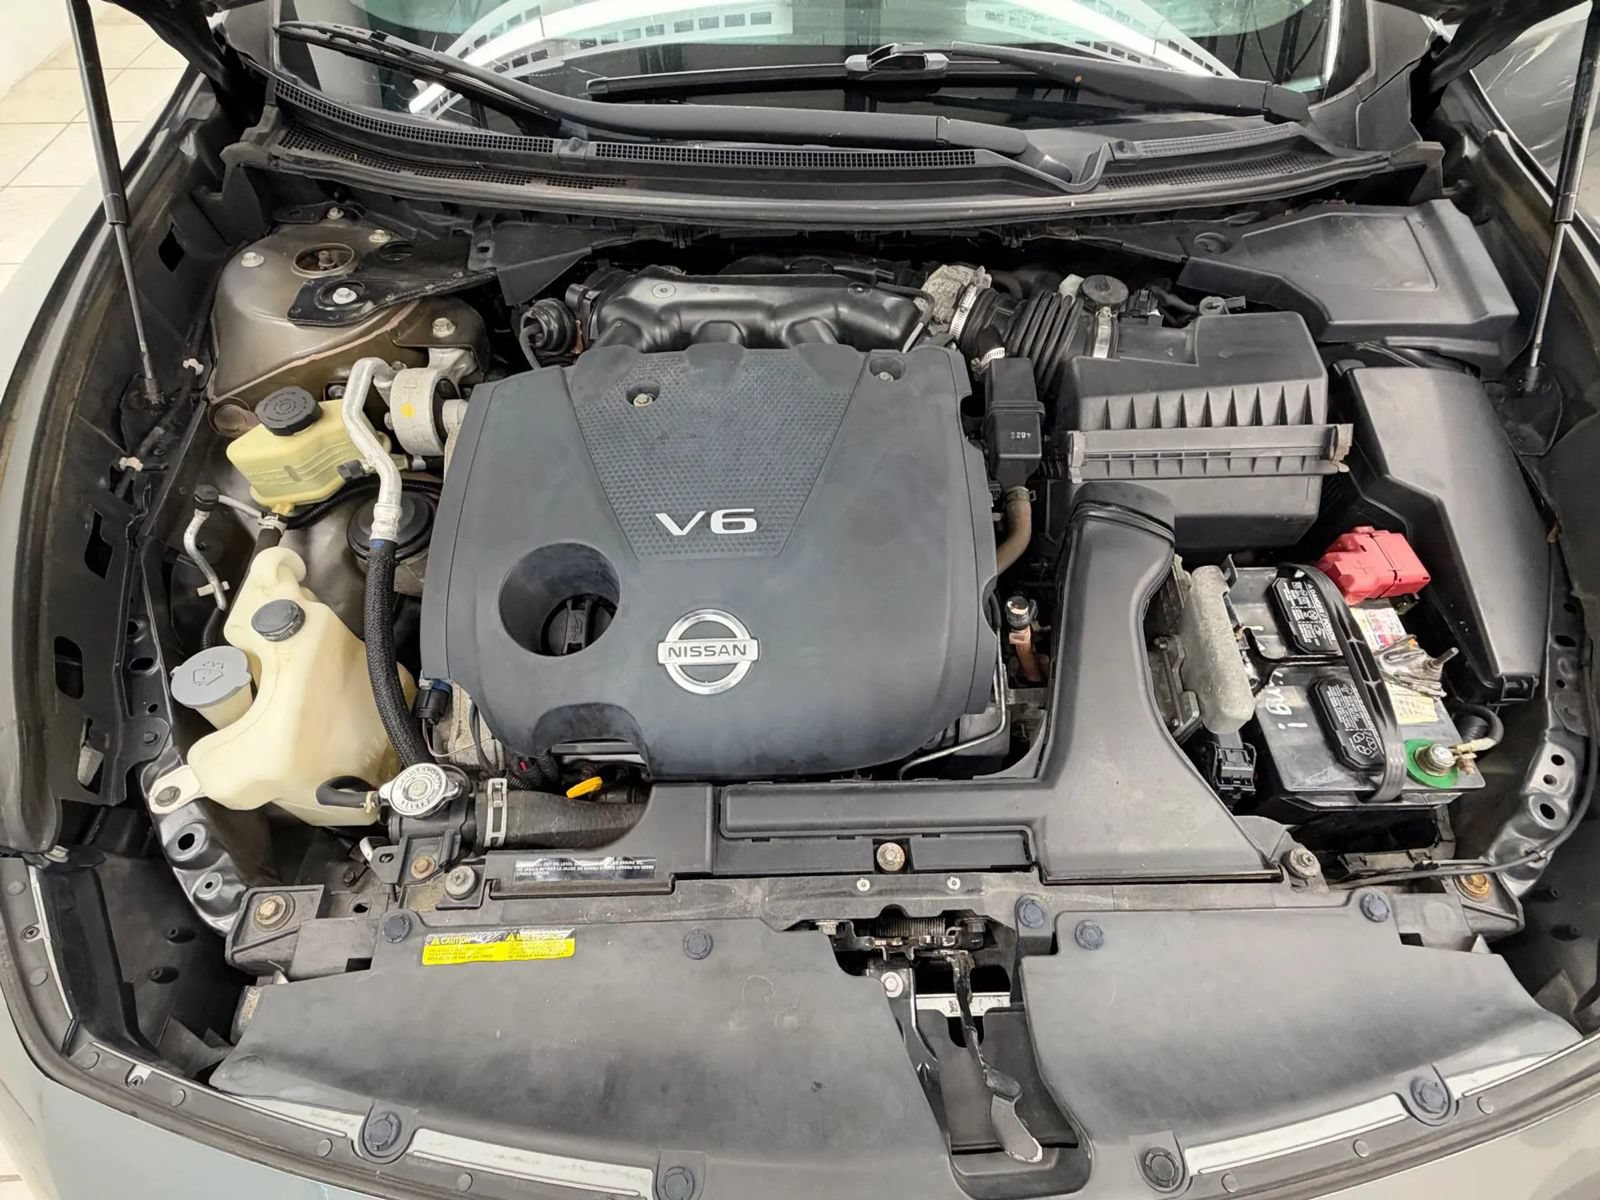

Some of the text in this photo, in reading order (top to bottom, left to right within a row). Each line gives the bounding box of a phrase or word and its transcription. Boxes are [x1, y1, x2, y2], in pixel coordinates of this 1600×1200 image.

[655, 508, 757, 536] V6
[668, 644, 747, 658] NISSAN
[441, 934, 471, 945] CAUTION
